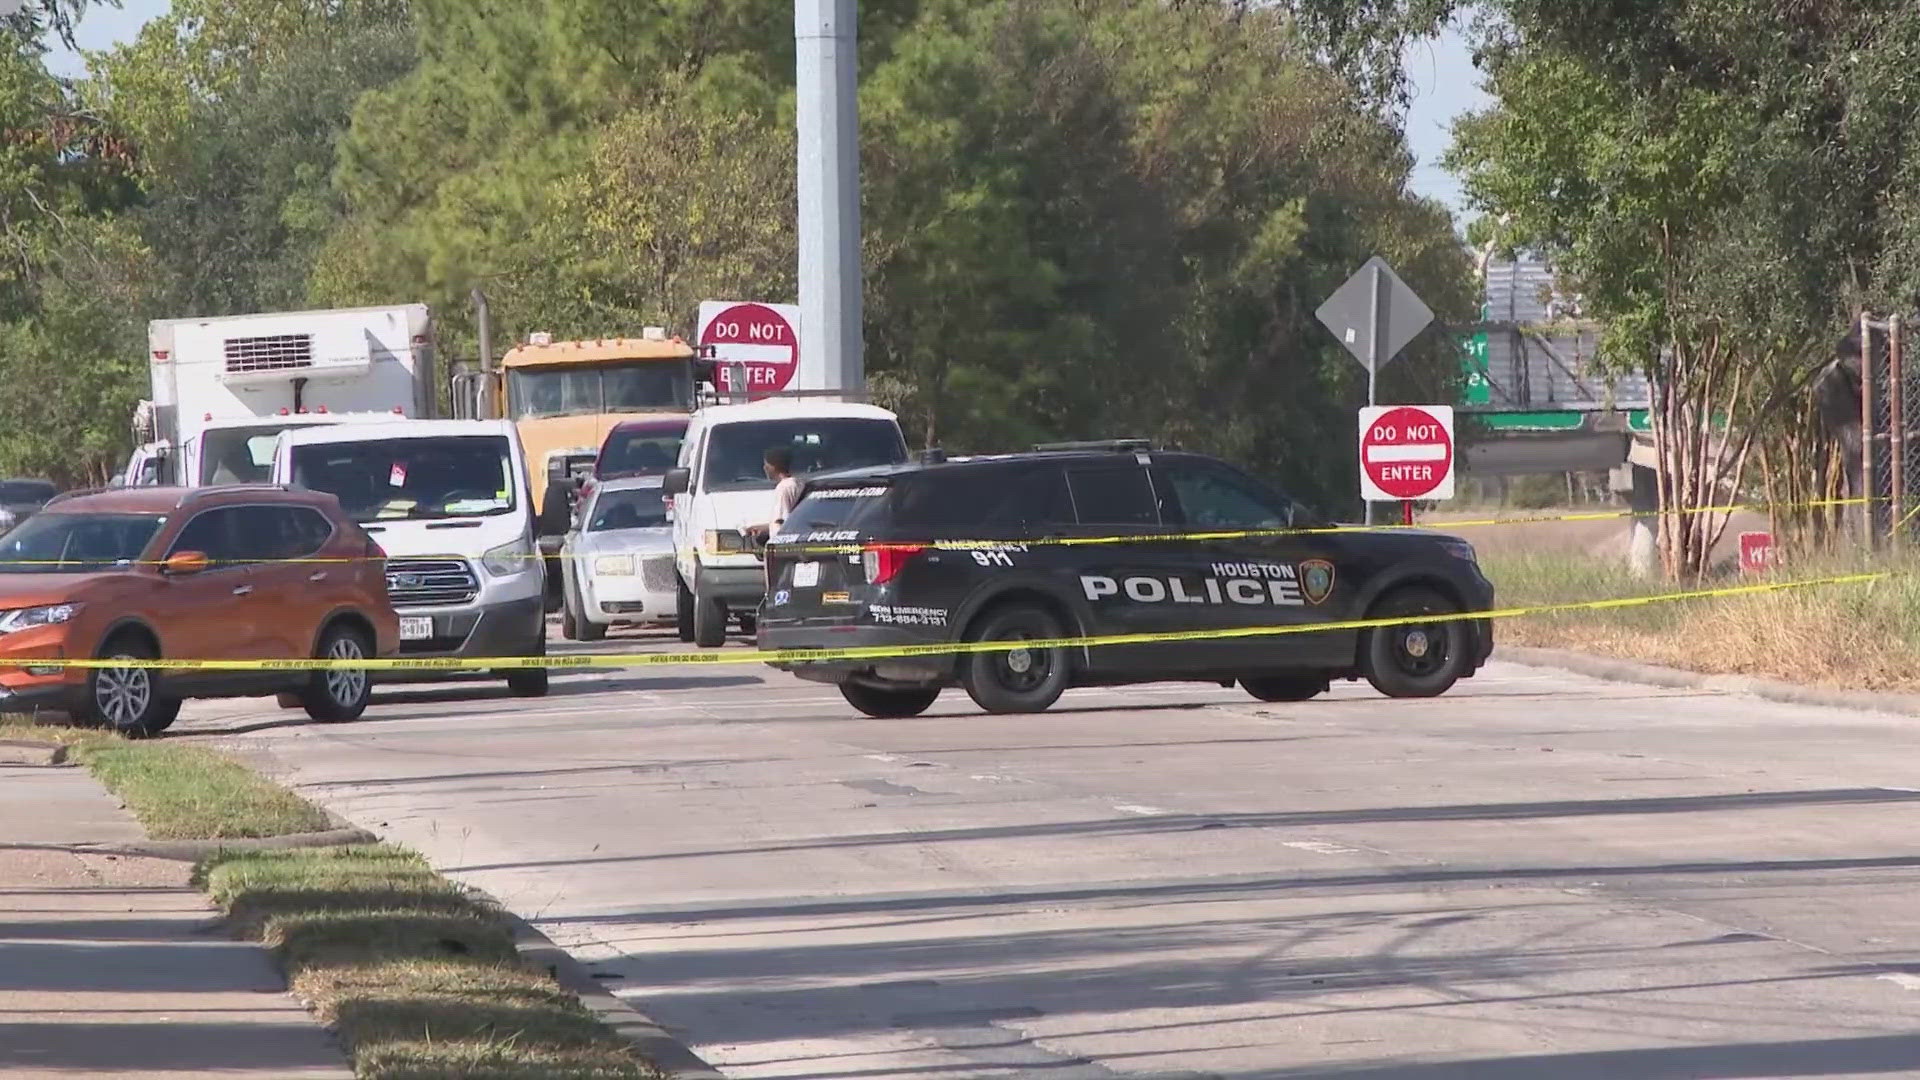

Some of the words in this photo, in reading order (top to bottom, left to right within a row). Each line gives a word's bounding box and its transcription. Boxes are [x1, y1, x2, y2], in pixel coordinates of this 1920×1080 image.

[716, 322, 739, 338] DO
[749, 323, 784, 340] NOT
[720, 367, 776, 384] ETER
[1374, 426, 1397, 441] DO
[1407, 425, 1437, 440] NOT
[1381, 466, 1432, 480] ENTER
[807, 531, 860, 542] POLICE
[971, 551, 1014, 566] 911
[1211, 563, 1296, 579] HOUSTON
[1080, 575, 1305, 606] POLICE
